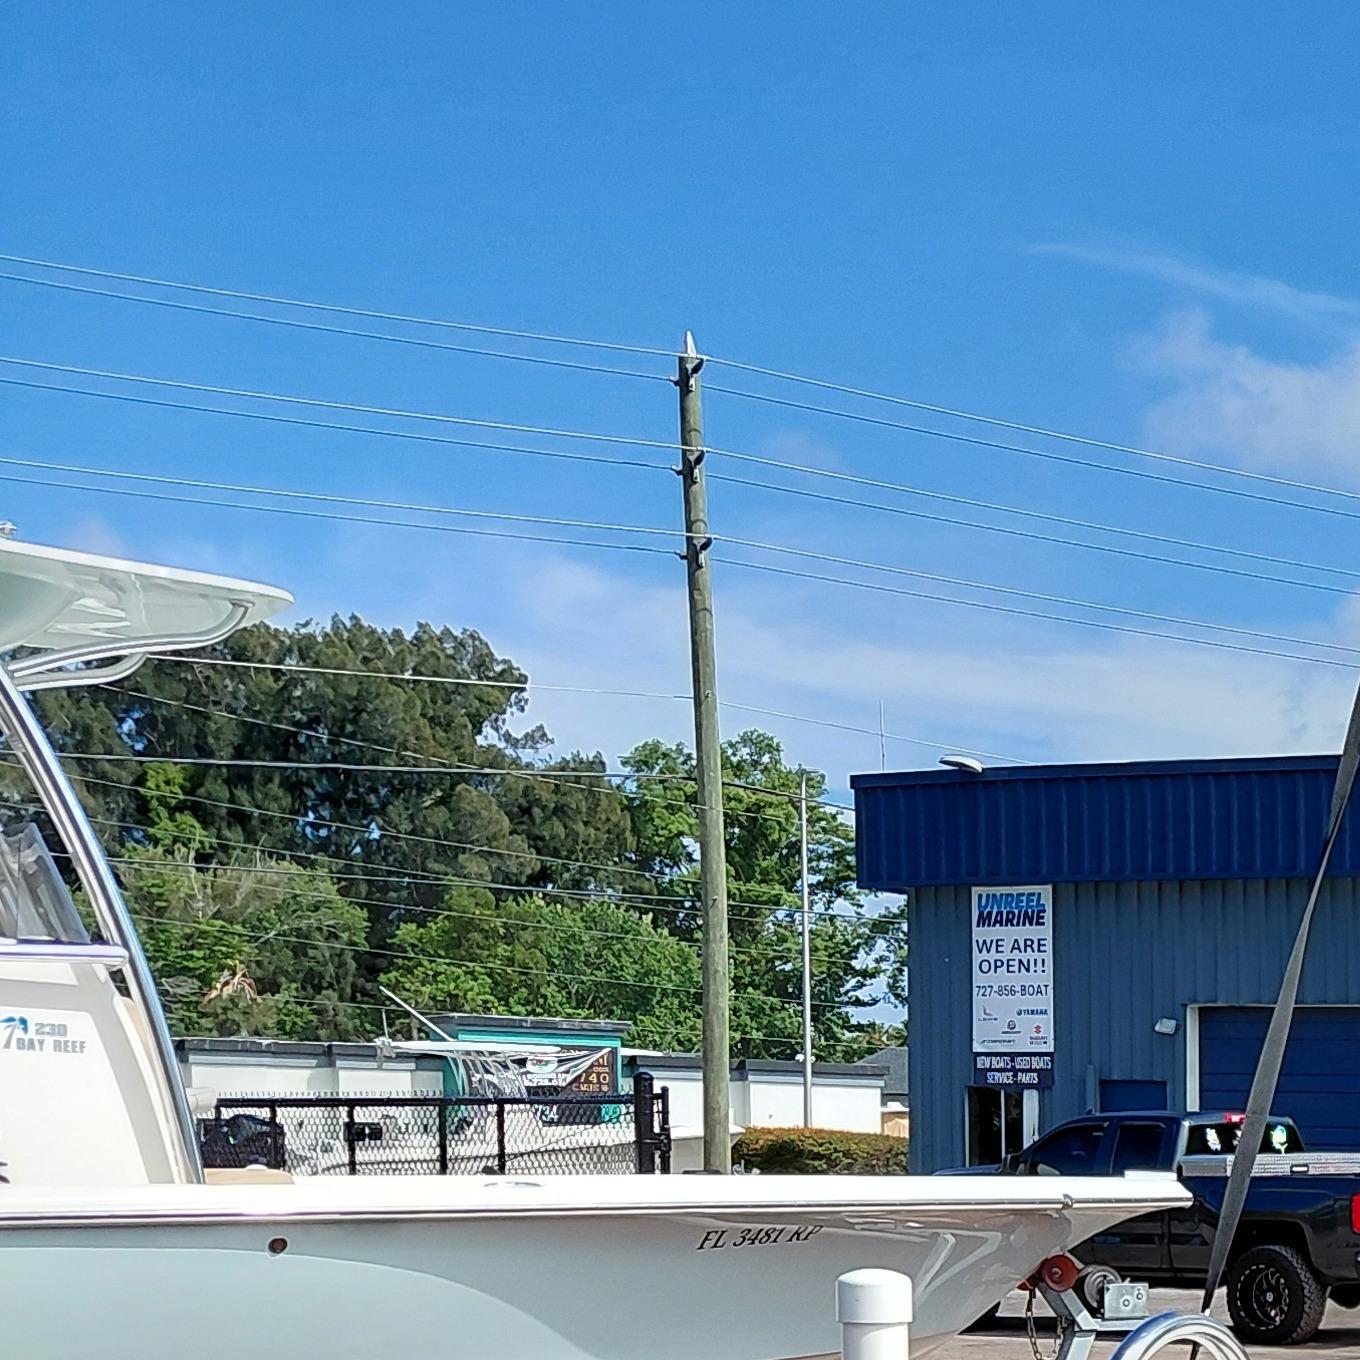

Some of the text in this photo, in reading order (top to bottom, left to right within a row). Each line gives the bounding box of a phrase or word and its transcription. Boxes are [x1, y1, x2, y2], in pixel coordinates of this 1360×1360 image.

[977, 891, 1046, 911] UNREEL
[976, 910, 1046, 928] MARINE
[975, 938, 1048, 954] WE ARE
[978, 958, 1046, 974] OPEN!!
[975, 984, 1050, 998] 727-856-BOAT
[34, 1022, 68, 1037] 230
[16, 1037, 87, 1054] BAY REEF
[991, 1056, 1011, 1069] BOATS
[1014, 1056, 1030, 1069] USED
[1031, 1056, 1052, 1069] BOATS
[986, 1071, 1014, 1084] SERVICE
[1017, 1072, 1039, 1084] PARTS
[696, 1229, 728, 1251] FL
[732, 1227, 786, 1248] 3481
